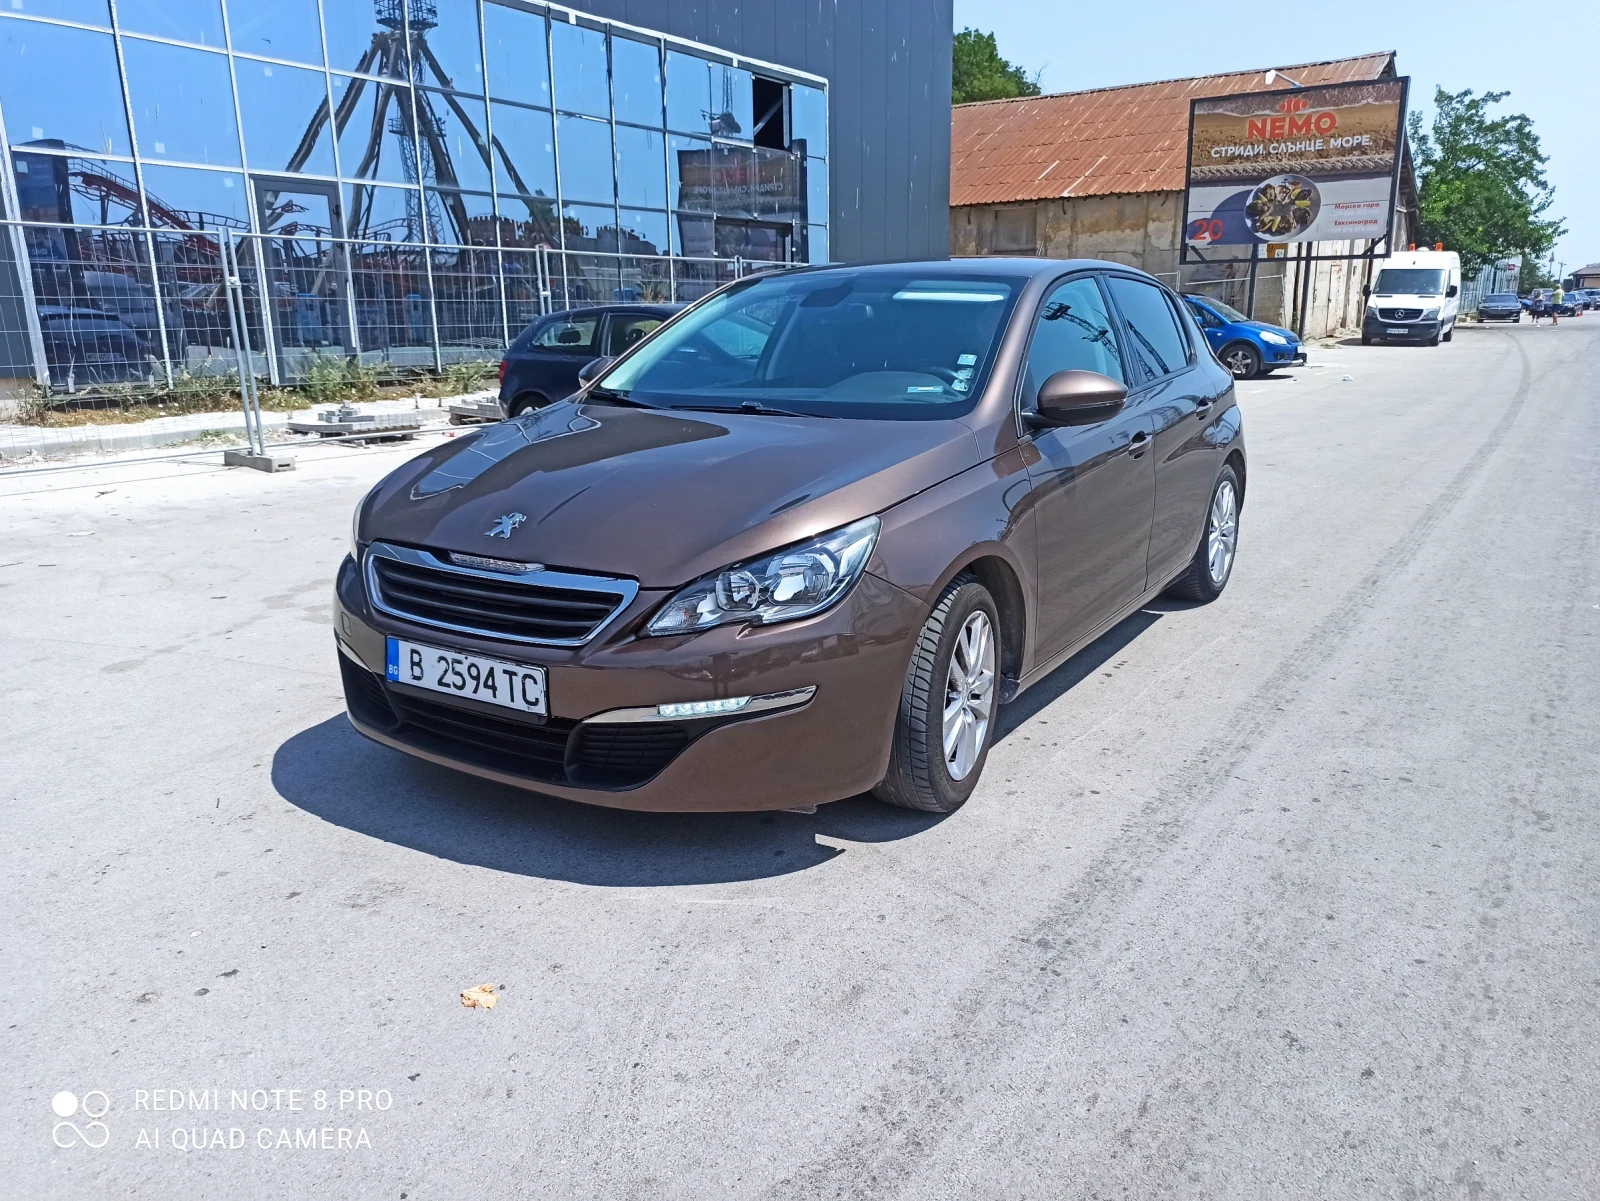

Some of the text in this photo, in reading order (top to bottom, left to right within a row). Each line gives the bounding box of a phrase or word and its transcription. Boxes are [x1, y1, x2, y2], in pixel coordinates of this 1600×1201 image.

[1247, 111, 1337, 140] NEMO
[1269, 139, 1326, 154] СЛЪНЦЕ.
[1329, 134, 1373, 149] МОРЕ.
[388, 664, 399, 675] BG
[410, 649, 424, 681] B
